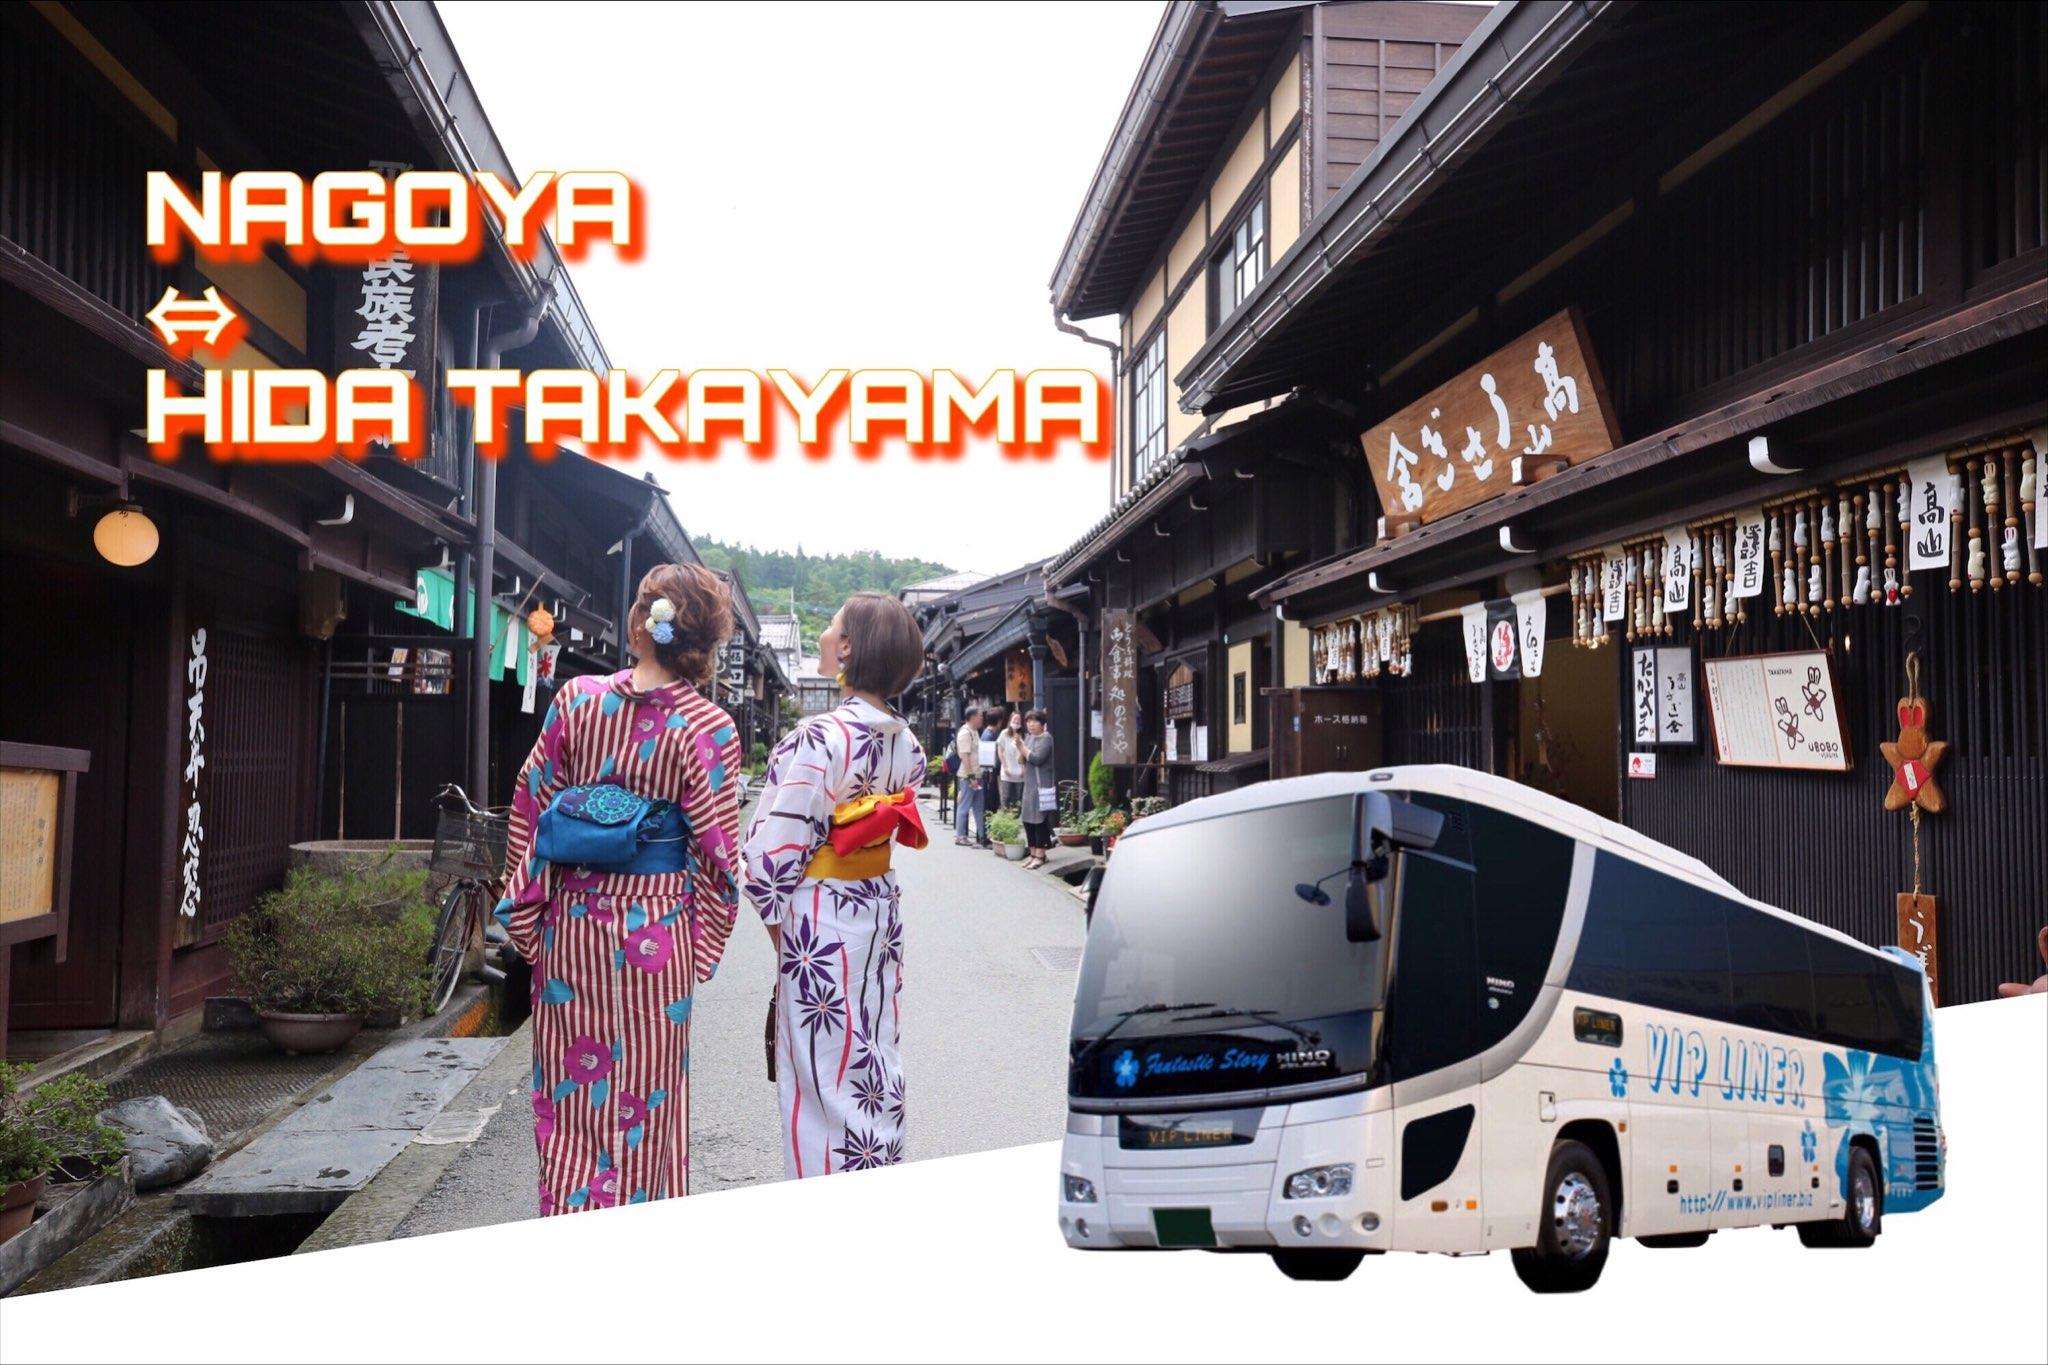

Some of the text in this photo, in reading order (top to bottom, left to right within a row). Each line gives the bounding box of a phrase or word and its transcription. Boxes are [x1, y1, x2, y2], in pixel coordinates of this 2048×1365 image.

[1916, 480, 1945, 559] 高山
[1668, 544, 1687, 604] 高山
[1144, 1048, 1270, 1077] Fantastic Story
[1645, 1022, 1806, 1110] VIP LINER
[1147, 1127, 1233, 1144] VIP LINER
[1680, 1189, 1813, 1214] http://www.vipliner.biz
